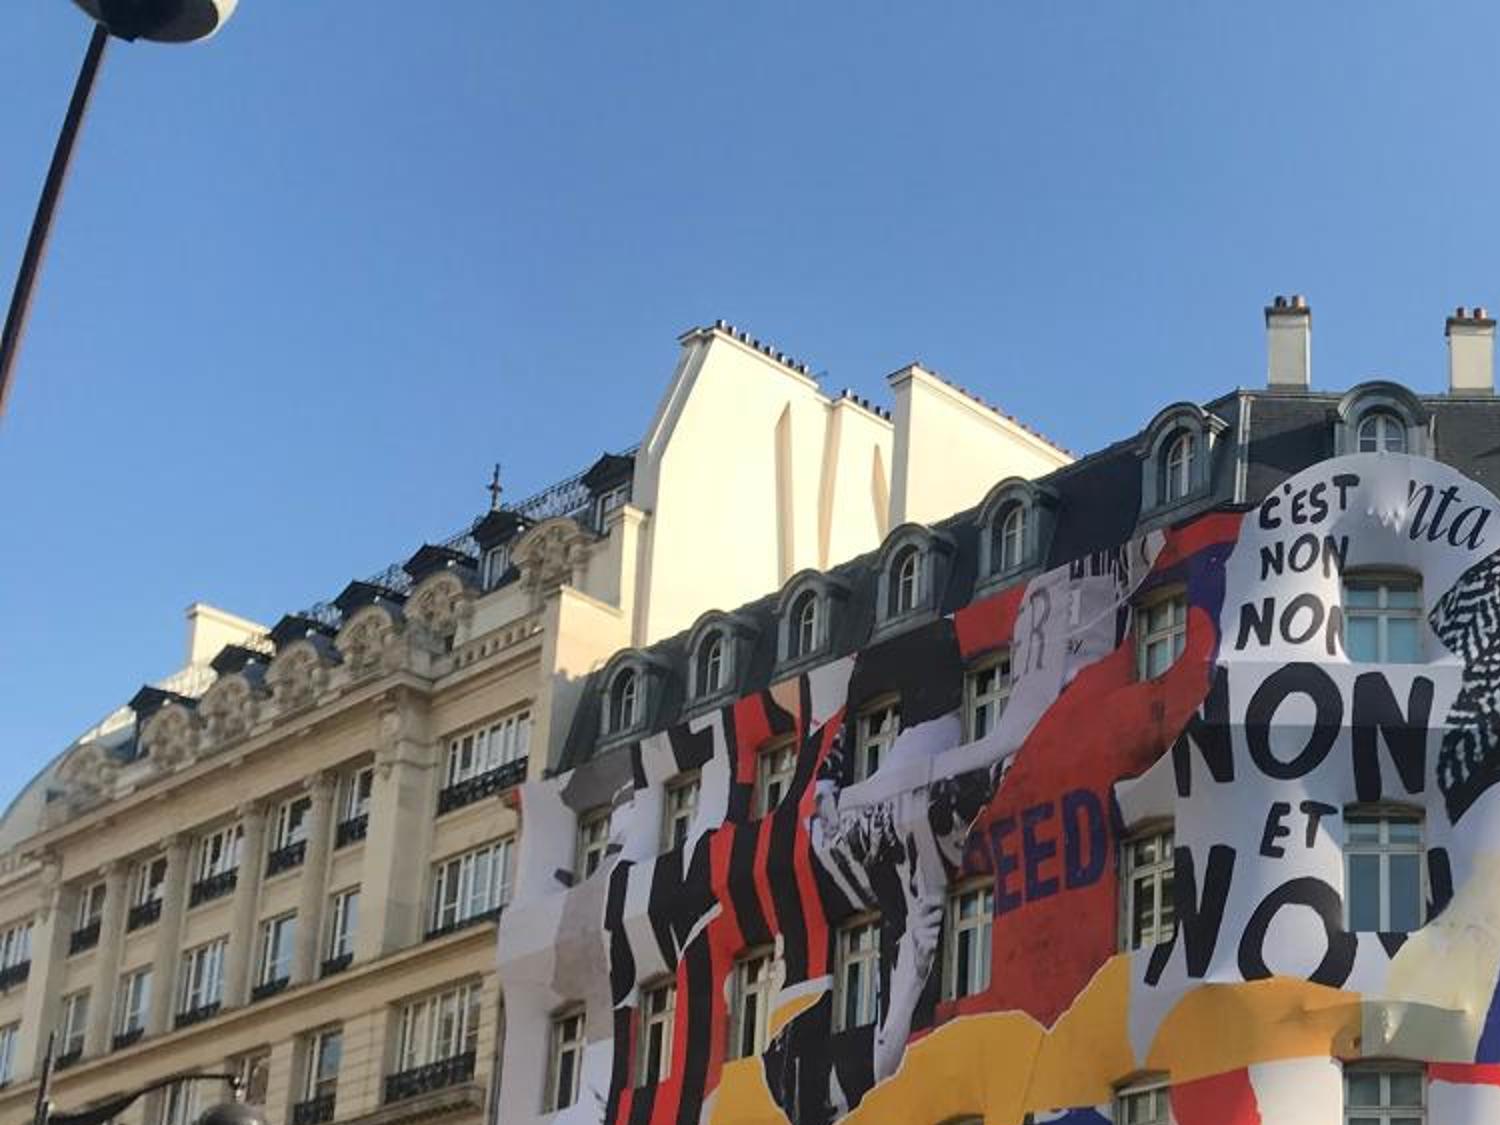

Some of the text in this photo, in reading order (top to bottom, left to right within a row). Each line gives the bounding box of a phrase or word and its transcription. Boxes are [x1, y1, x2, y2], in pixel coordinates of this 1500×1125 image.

[1259, 473, 1359, 530] C'EST
[1259, 533, 1349, 581] NON
[1172, 661, 1434, 803] NON
[1260, 800, 1340, 858] ET
